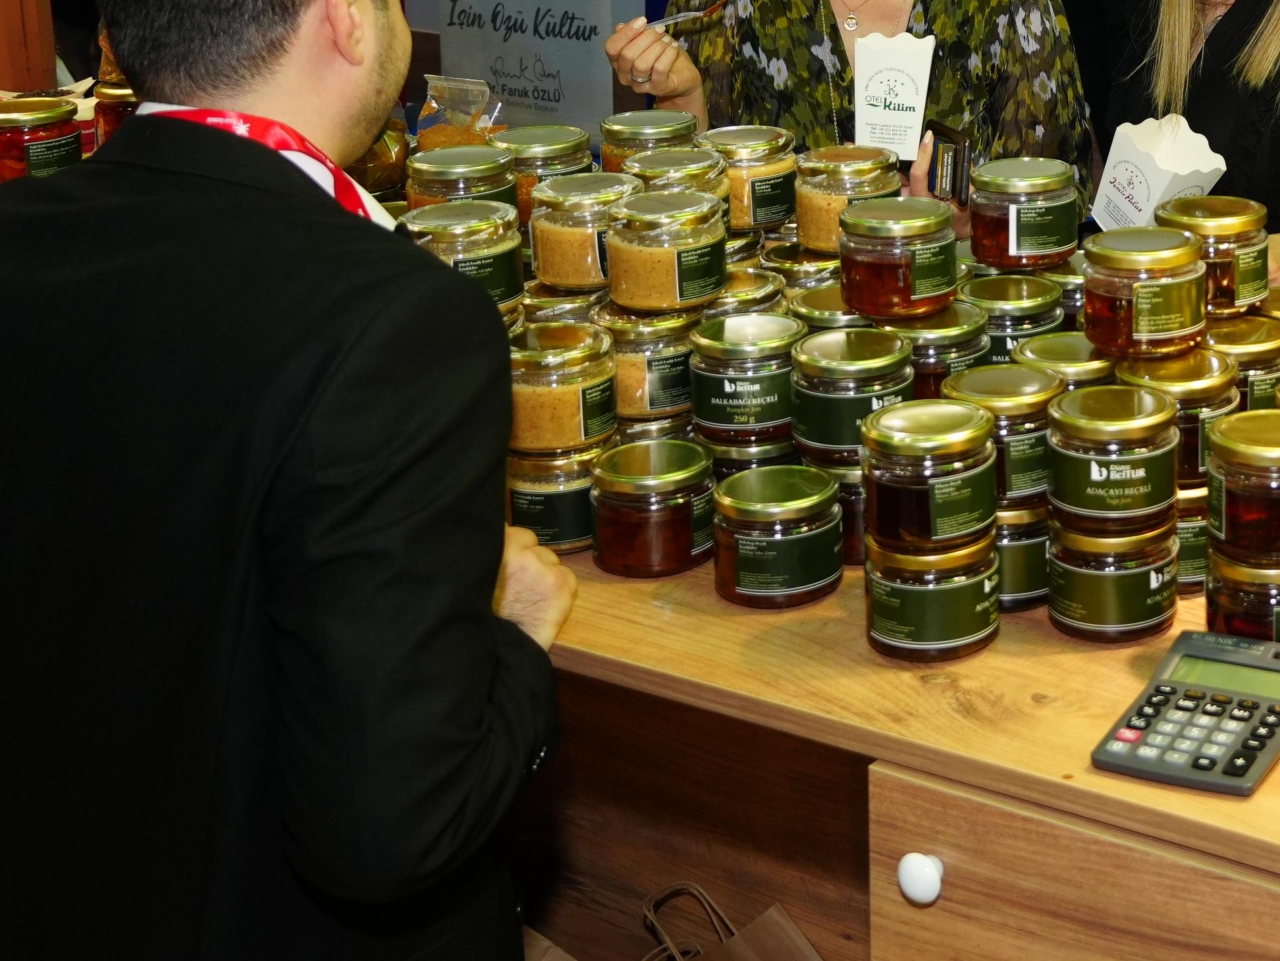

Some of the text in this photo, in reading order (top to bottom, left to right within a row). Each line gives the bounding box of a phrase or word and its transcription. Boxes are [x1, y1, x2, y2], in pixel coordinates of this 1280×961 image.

[533, 6, 599, 41] Kültür
[501, 84, 530, 99] Faruk
[532, 86, 561, 103] ÖZLÜ
[865, 95, 916, 113] OTEL Kilim
[733, 415, 748, 424] 250
[1085, 483, 1152, 497] ADAÇAYI REÇELİ
[1202, 715, 1213, 724] 8
[1227, 720, 1238, 729] 9
[1190, 727, 1201, 736] 5
[1216, 732, 1228, 741] 6
[1112, 741, 1158, 756] 0 00
[1180, 739, 1191, 749] 2
[1207, 744, 1219, 754] 3
